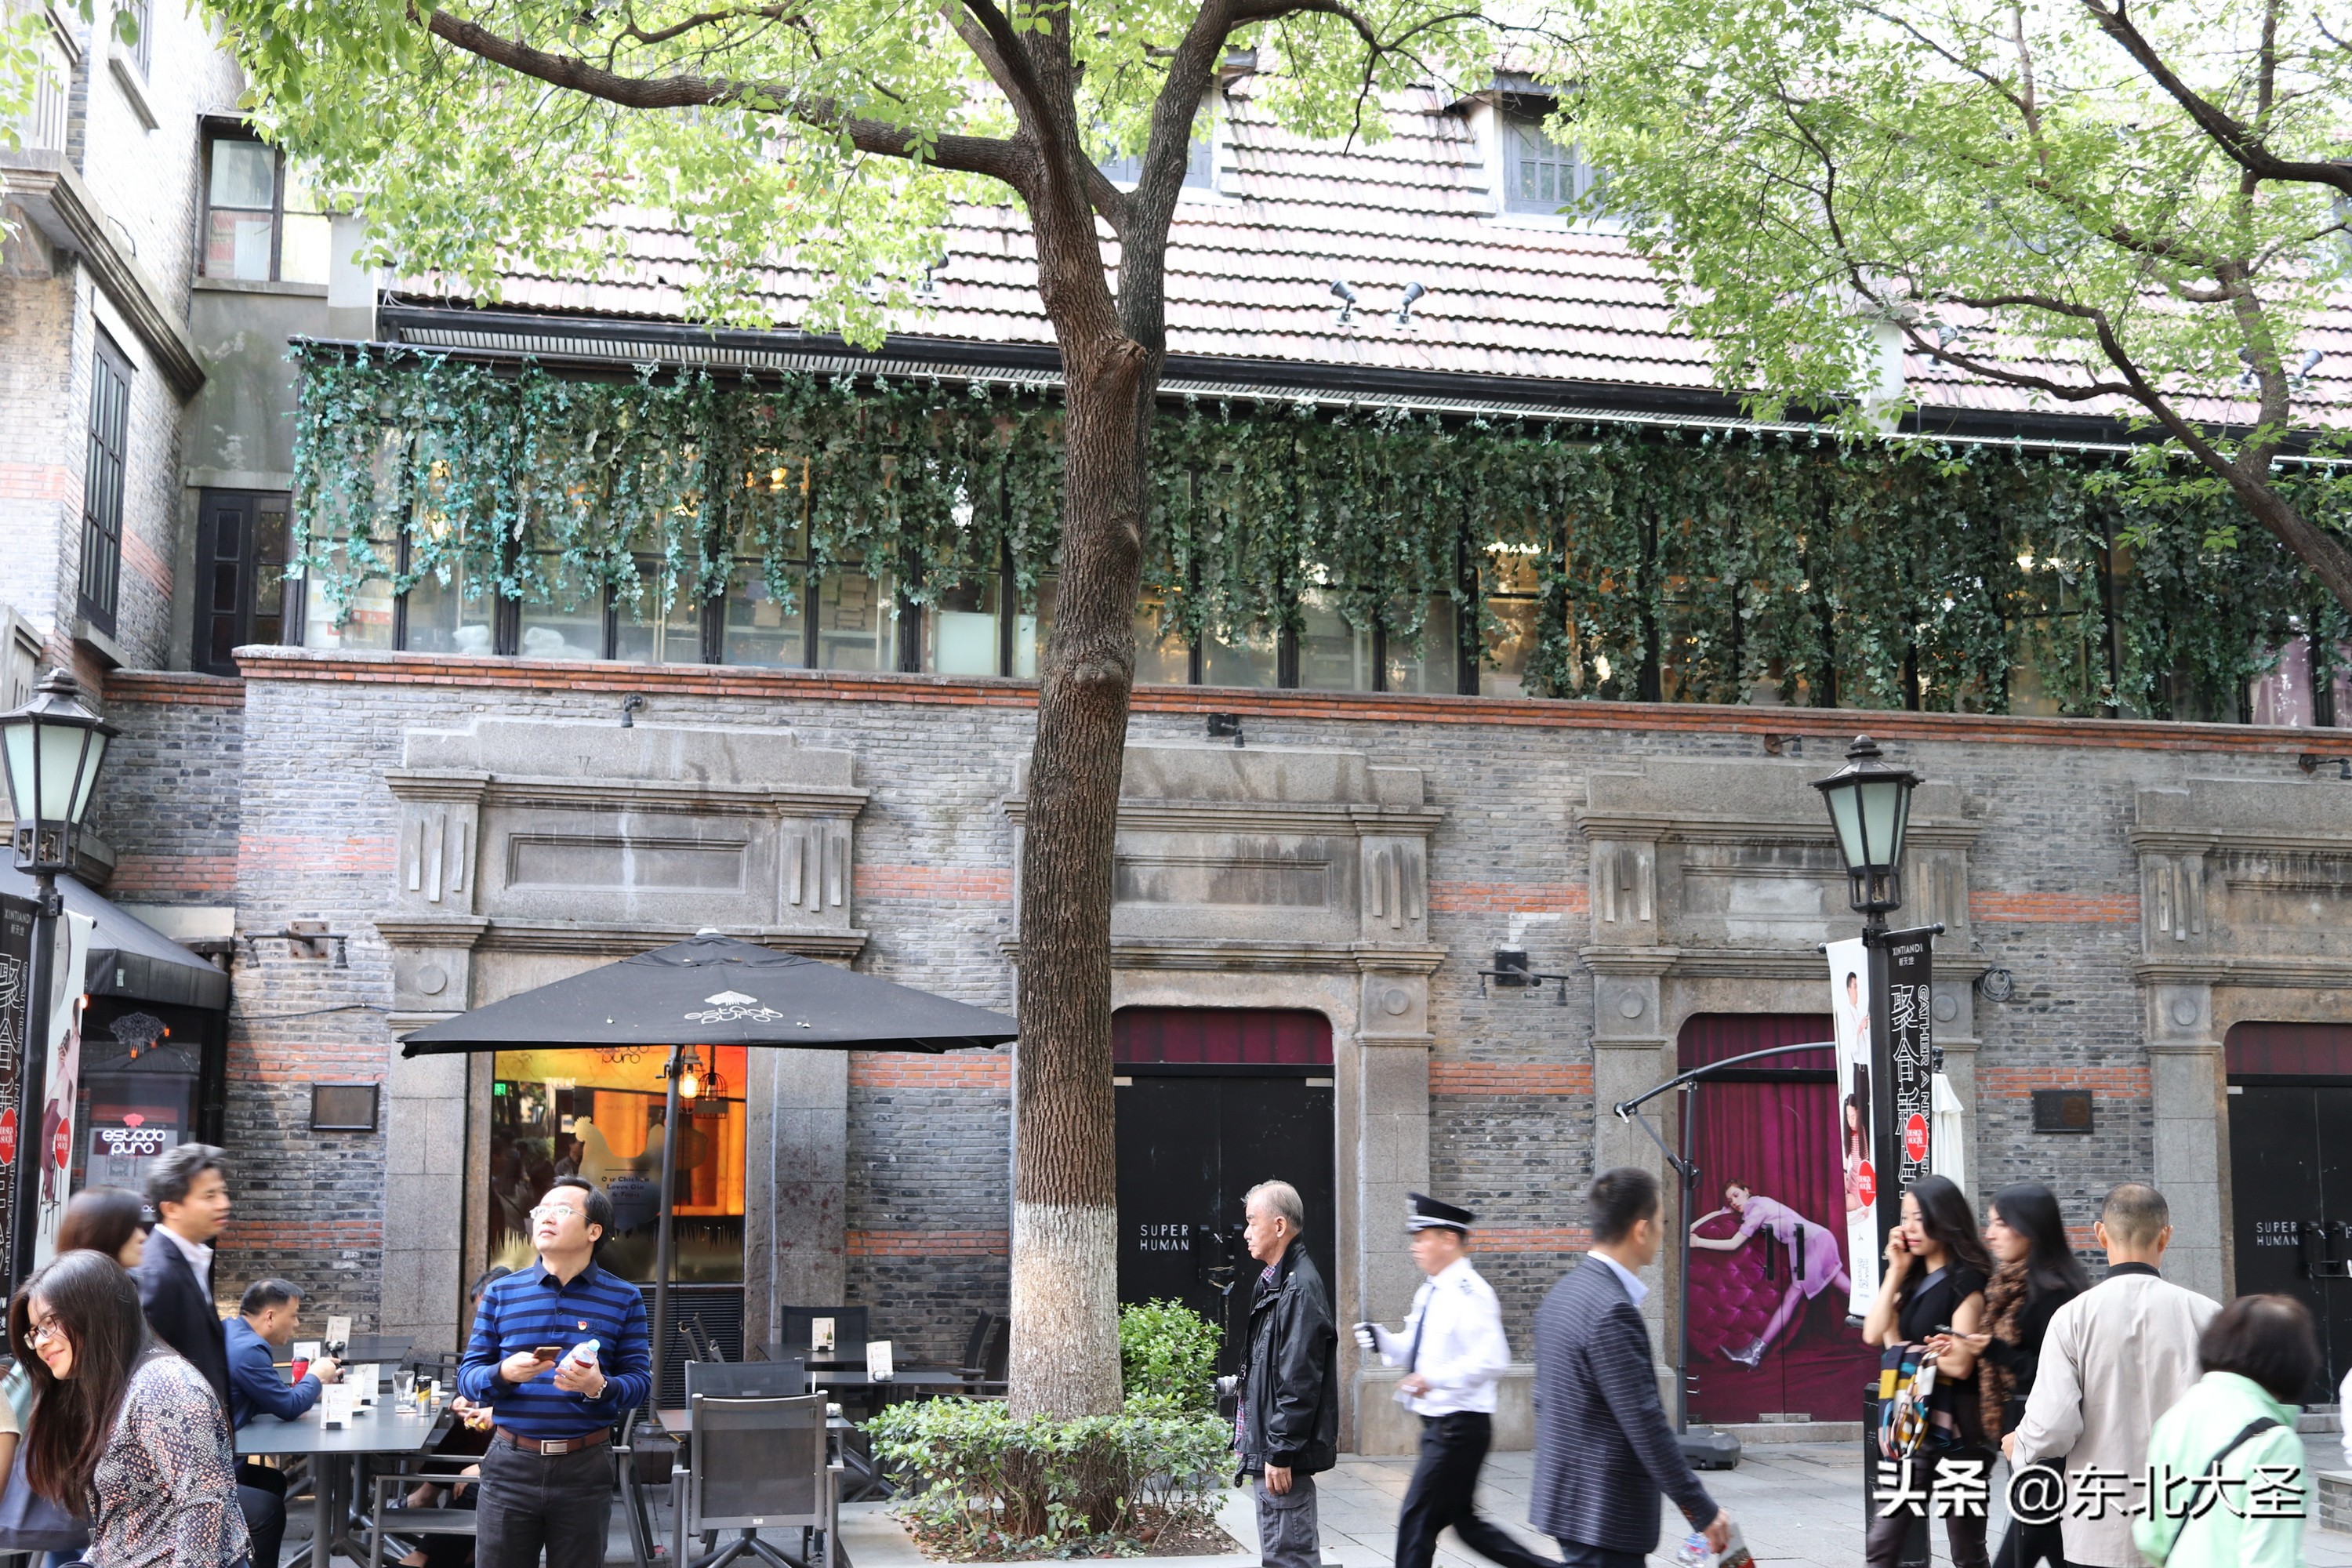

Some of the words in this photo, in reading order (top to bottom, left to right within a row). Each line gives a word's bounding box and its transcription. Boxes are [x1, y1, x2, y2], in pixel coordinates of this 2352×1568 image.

[4, 909, 32, 924] XINTIANDI
[1892, 943, 1923, 956] XINTIANDI
[1899, 956, 1915, 966] 新天地
[684, 1006, 783, 1019] estado
[701, 1012, 771, 1024] puro
[1918, 985, 1930, 1066] GATHER
[602, 1054, 641, 1064] puro
[1921, 1070, 1929, 1088] A
[102, 1128, 166, 1142] estado
[111, 1142, 155, 1156] puro
[1140, 1225, 1189, 1236] SUPER
[2256, 1221, 2297, 1233] SUPER
[1140, 1239, 1189, 1250] HUMAN
[2256, 1235, 2299, 1246] HUMAN
